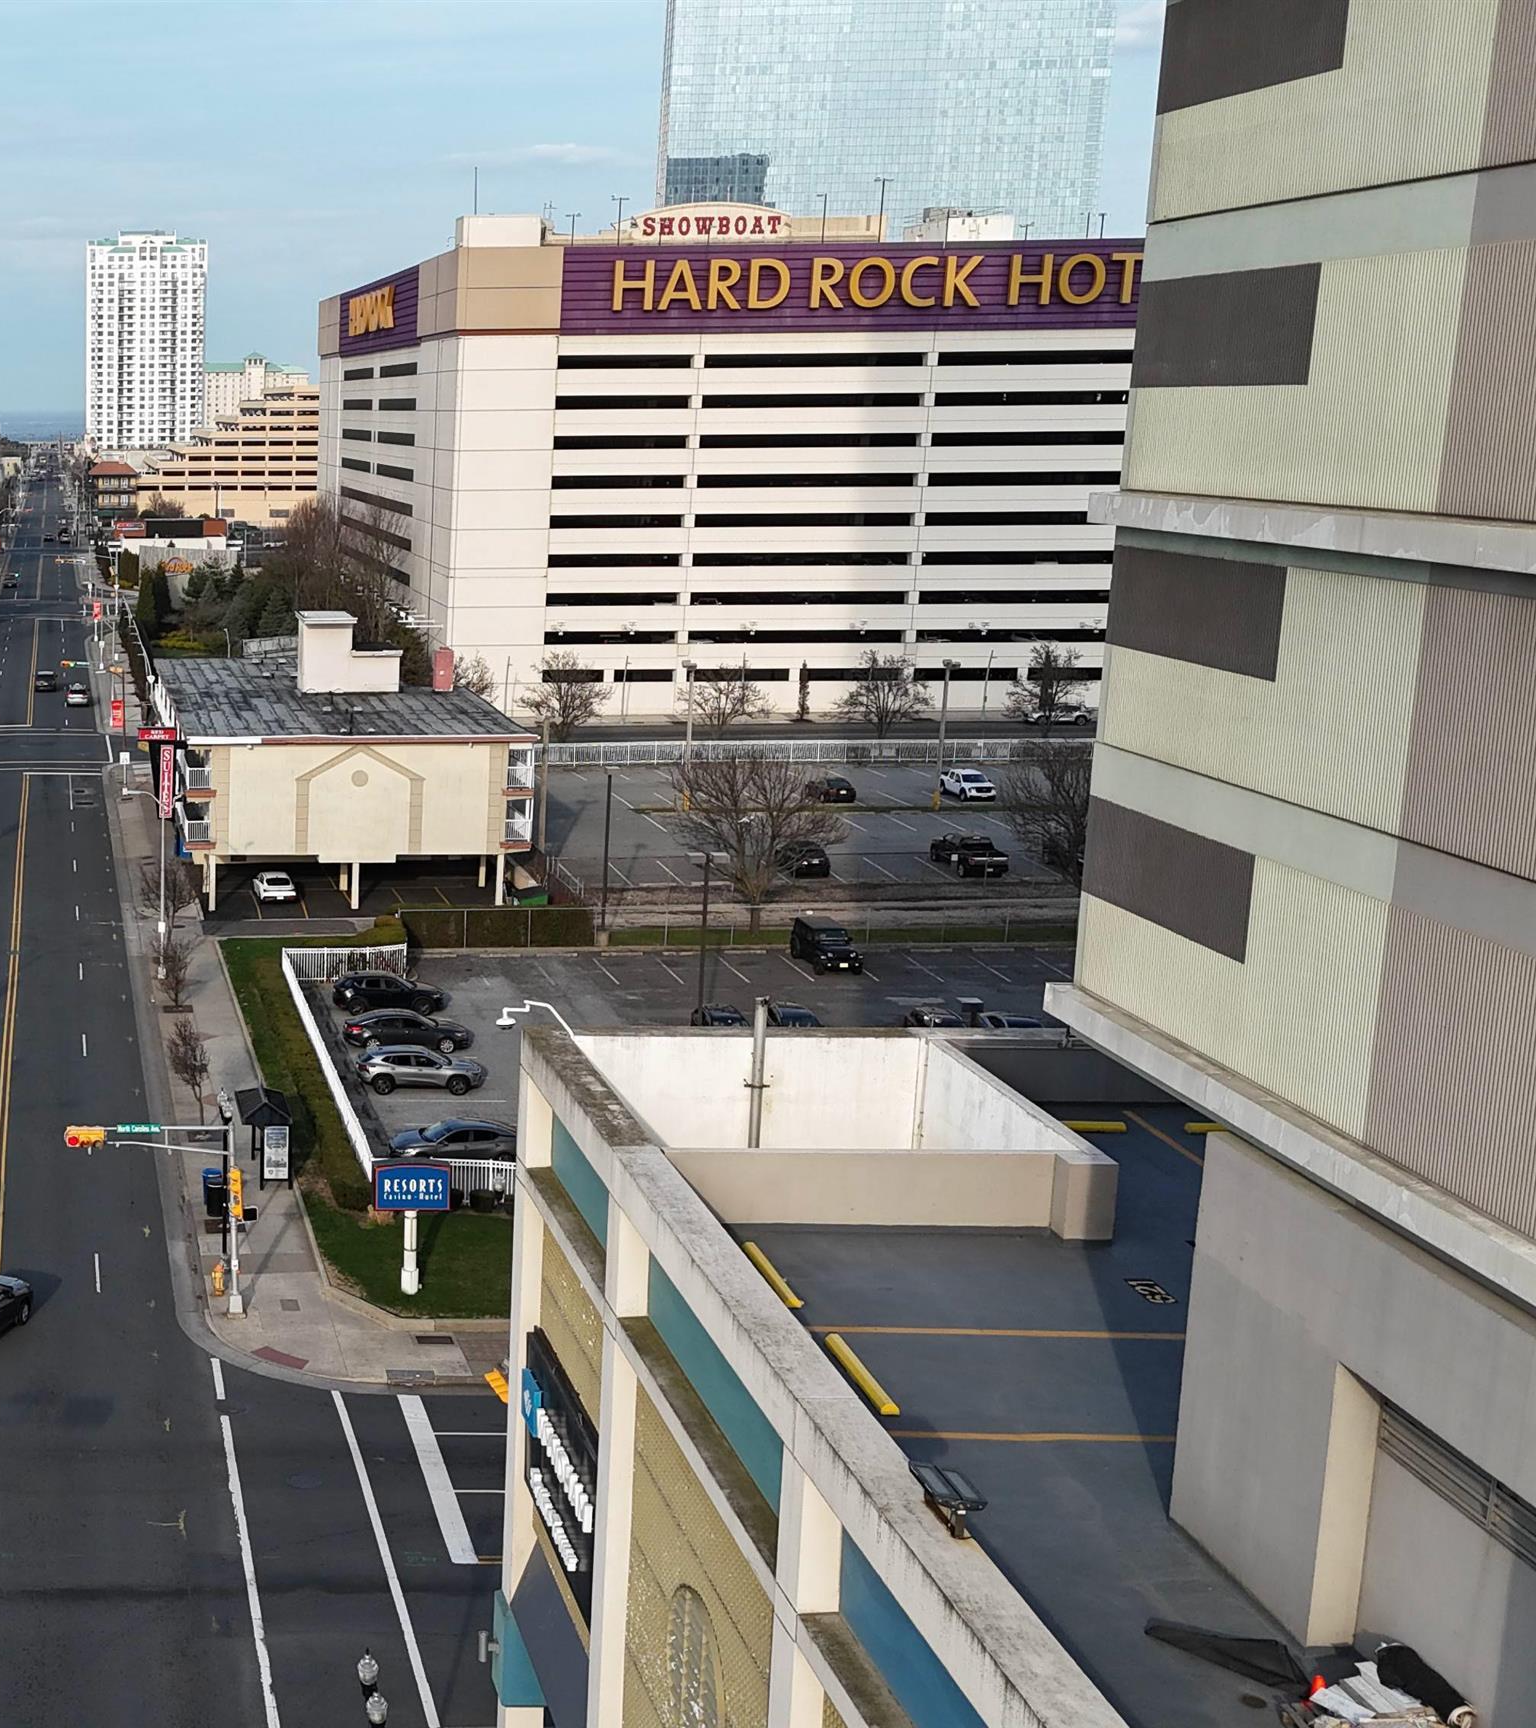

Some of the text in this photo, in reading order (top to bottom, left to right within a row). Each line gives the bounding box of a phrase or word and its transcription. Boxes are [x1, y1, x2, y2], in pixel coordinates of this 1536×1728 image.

[642, 215, 783, 236] SHOWBOAT
[611, 252, 1144, 312] HARD ROCK HOT
[384, 1179, 443, 1193] RESORTS
